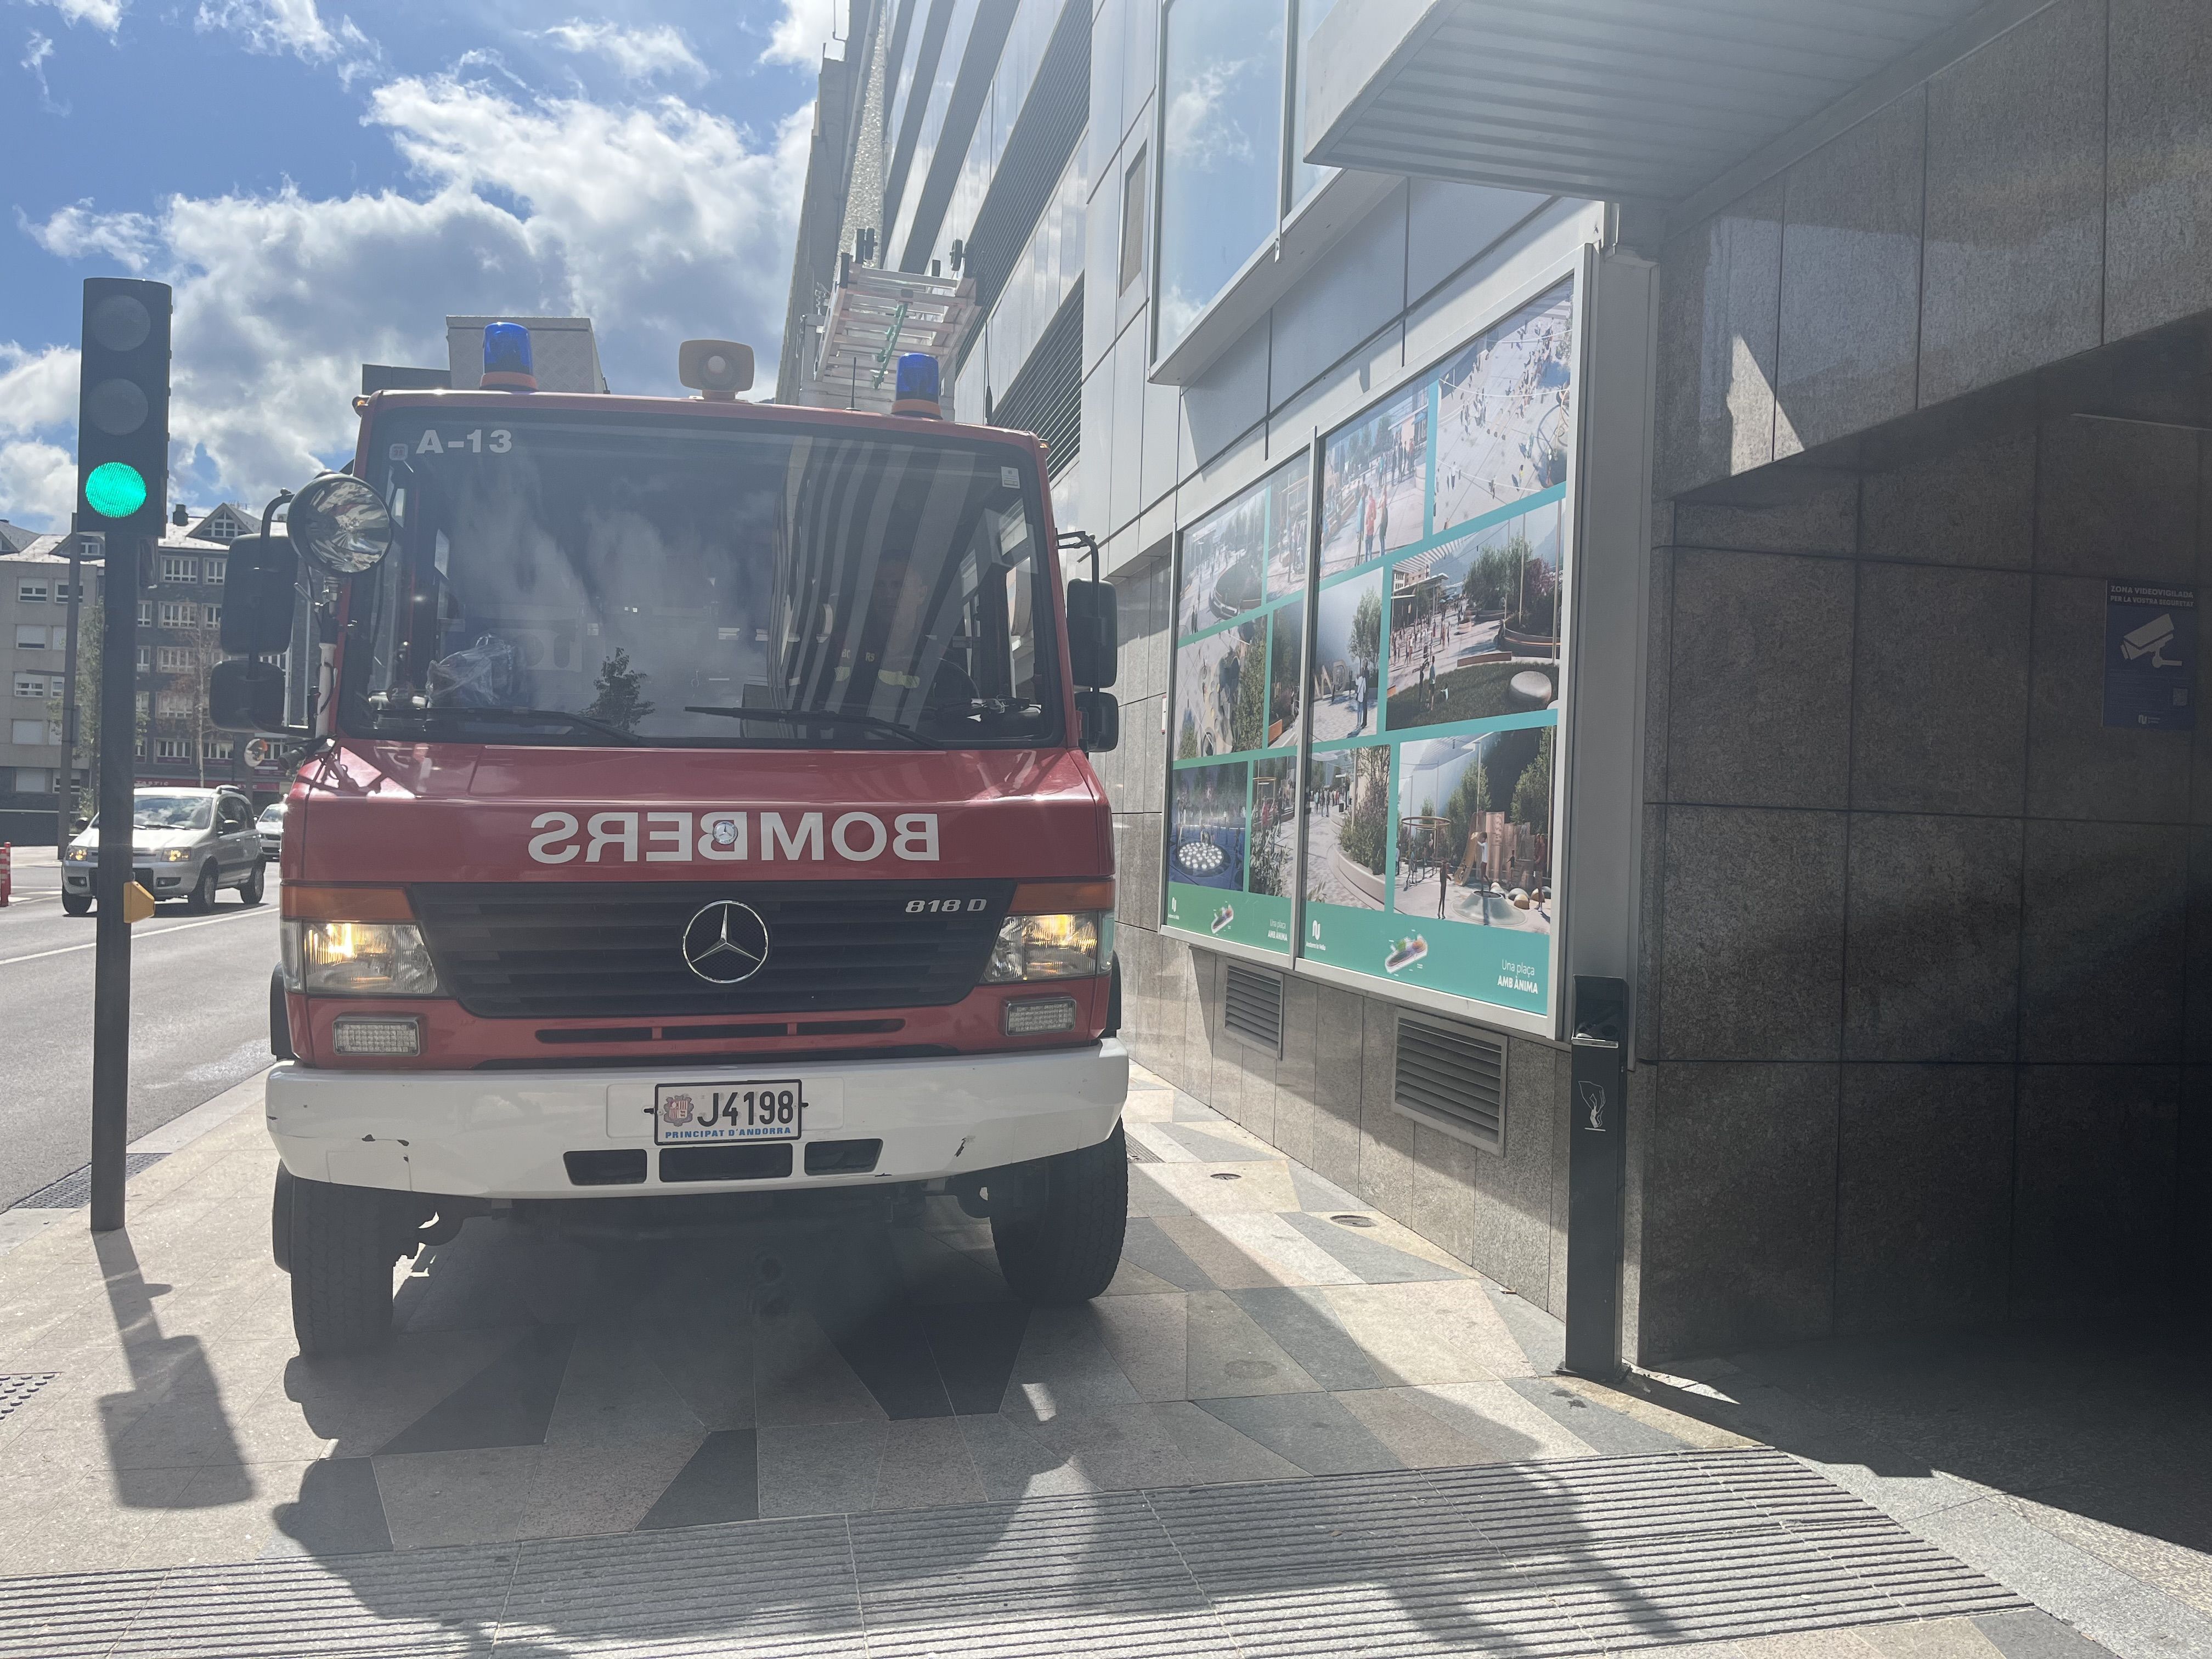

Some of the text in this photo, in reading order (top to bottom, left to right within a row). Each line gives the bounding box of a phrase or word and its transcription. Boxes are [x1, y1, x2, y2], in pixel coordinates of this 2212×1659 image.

[416, 429, 512, 454] A-13
[2111, 585, 2194, 599] ZONA VIDEOVIGILADA
[2159, 599, 2194, 607] SEGURETAT
[905, 899, 987, 913] 818 D
[1502, 959, 1535, 978] Una plaça
[1497, 975, 1538, 994] AMB ÀNIMA
[697, 1090, 793, 1127] J4198
[665, 1127, 791, 1138] PRINCIPAT D'ANDORRA
